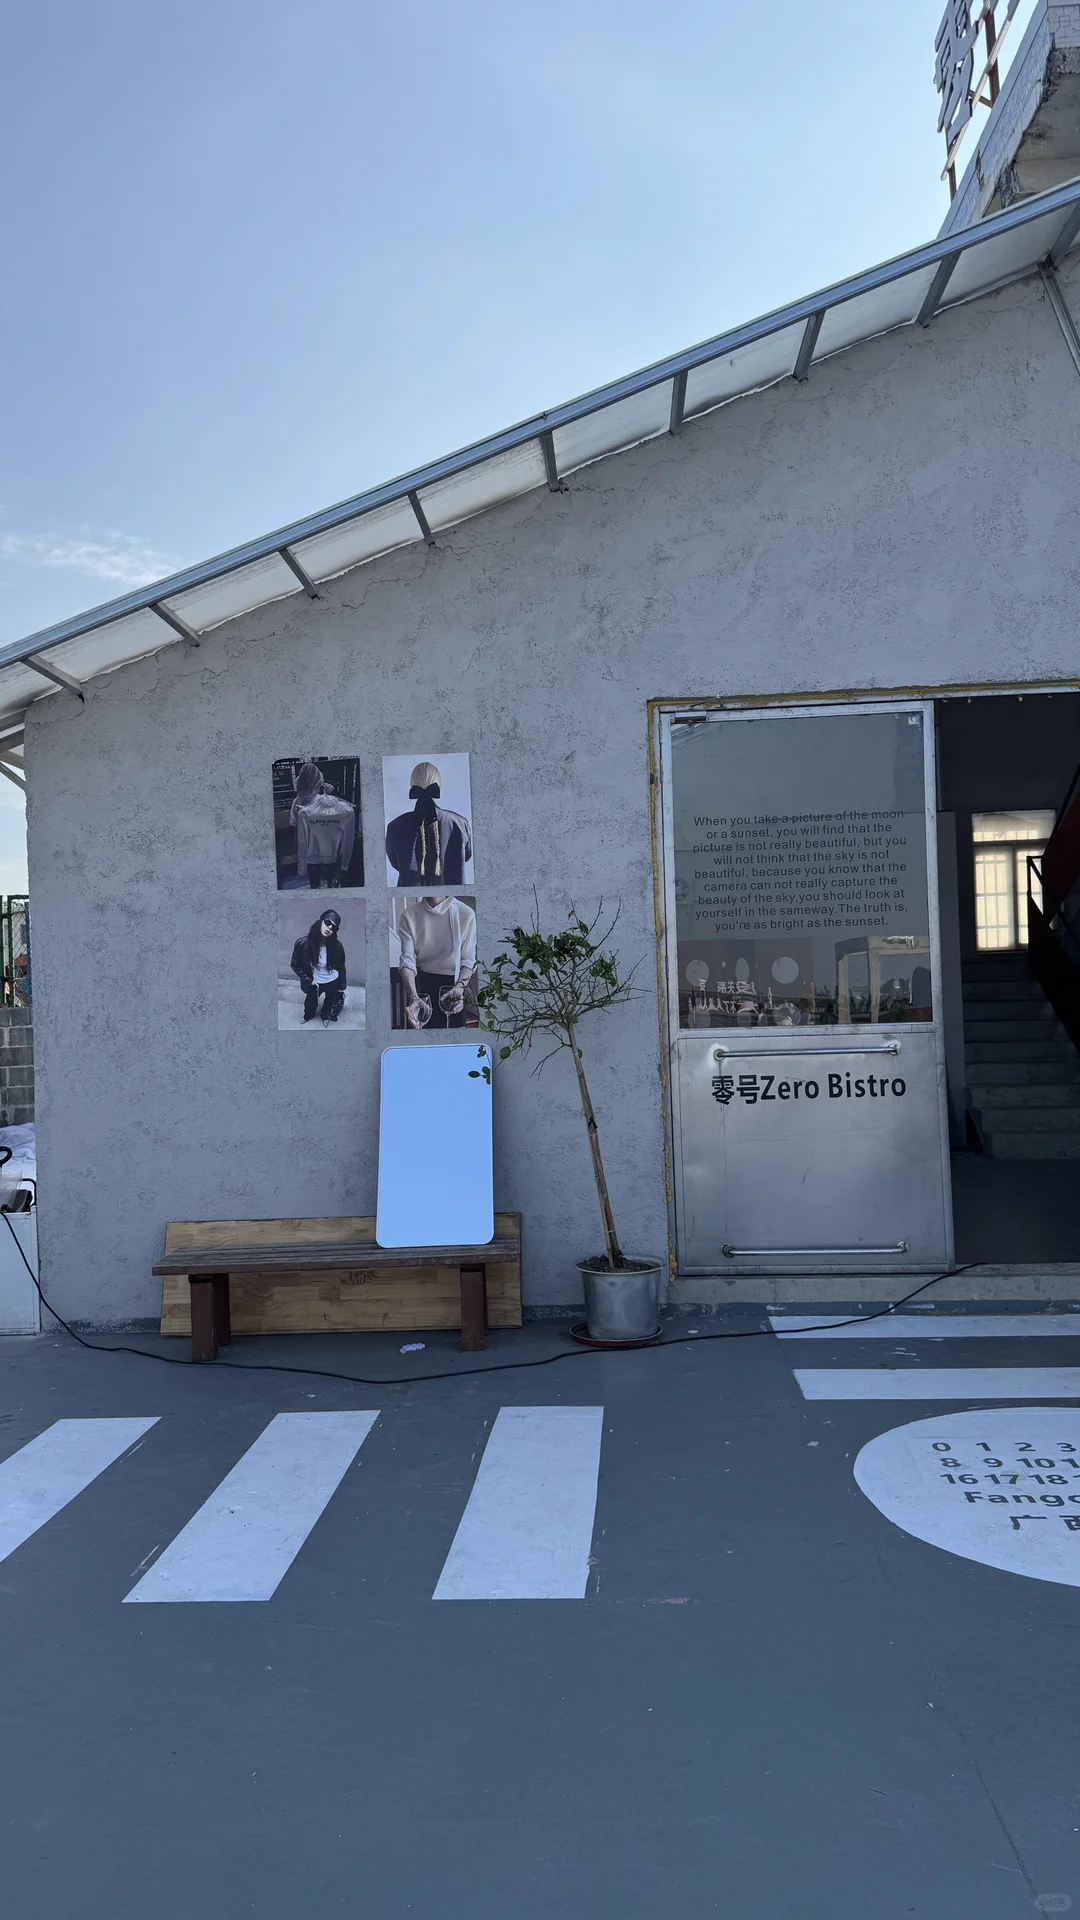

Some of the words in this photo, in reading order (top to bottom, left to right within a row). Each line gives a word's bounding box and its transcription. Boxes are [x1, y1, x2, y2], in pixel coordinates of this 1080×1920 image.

[694, 817, 726, 826] When
[730, 818, 750, 827] you
[754, 815, 778, 823] take
[782, 815, 788, 823] a
[792, 813, 832, 824] picture
[836, 811, 846, 820] of
[850, 811, 867, 820] the
[872, 811, 904, 819] moon
[706, 831, 718, 839] or
[721, 831, 727, 839] a
[777, 828, 797, 838] you
[800, 826, 819, 835] will
[823, 825, 844, 834] find
[848, 824, 870, 833] that
[874, 823, 891, 832] the
[693, 843, 732, 854] picture
[736, 842, 745, 851] is
[749, 841, 766, 850] not
[770, 840, 802, 851] really
[805, 837, 860, 848] beautiful,
[864, 837, 882, 846] but
[886, 837, 906, 847] you
[714, 855, 732, 864] will
[736, 855, 754, 864] not
[757, 853, 784, 863] think
[788, 853, 810, 862] that
[814, 852, 831, 861] the
[835, 851, 854, 862] sky
[858, 850, 867, 859] is
[871, 850, 889, 859] not
[694, 868, 749, 878] beautiful,
[752, 868, 801, 877] because
[805, 867, 825, 877] you
[829, 864, 860, 874] know
[862, 863, 885, 872] that
[888, 862, 906, 871] the
[704, 883, 747, 891] camera
[750, 882, 770, 890] can
[775, 880, 792, 888] not
[796, 879, 828, 889] really
[831, 878, 876, 888] capture
[880, 876, 898, 885] the
[698, 896, 737, 906] beauty
[741, 894, 751, 903] of
[755, 894, 772, 903] the
[823, 890, 862, 900] should
[866, 889, 890, 899] look
[893, 889, 904, 898] at
[696, 907, 742, 920] yourself
[745, 907, 754, 916] in
[759, 907, 776, 916] the
[864, 903, 891, 912] truth
[715, 921, 750, 933] you're
[771, 919, 804, 930] bright
[807, 920, 820, 928] as
[824, 918, 842, 927] the
[845, 916, 888, 926] sunset.
[828, 1072, 906, 1098] Bistro
[932, 1442, 952, 1452] 0
[976, 1442, 992, 1451] 1
[1014, 1442, 1036, 1452] 2
[1056, 1442, 1076, 1452] 3
[940, 1458, 962, 1468] 8
[983, 1458, 1003, 1468] 9
[1016, 1458, 1055, 1468] 10
[940, 1474, 979, 1484] 16
[984, 1474, 1019, 1484] 17
[1028, 1474, 1069, 1485] 18
